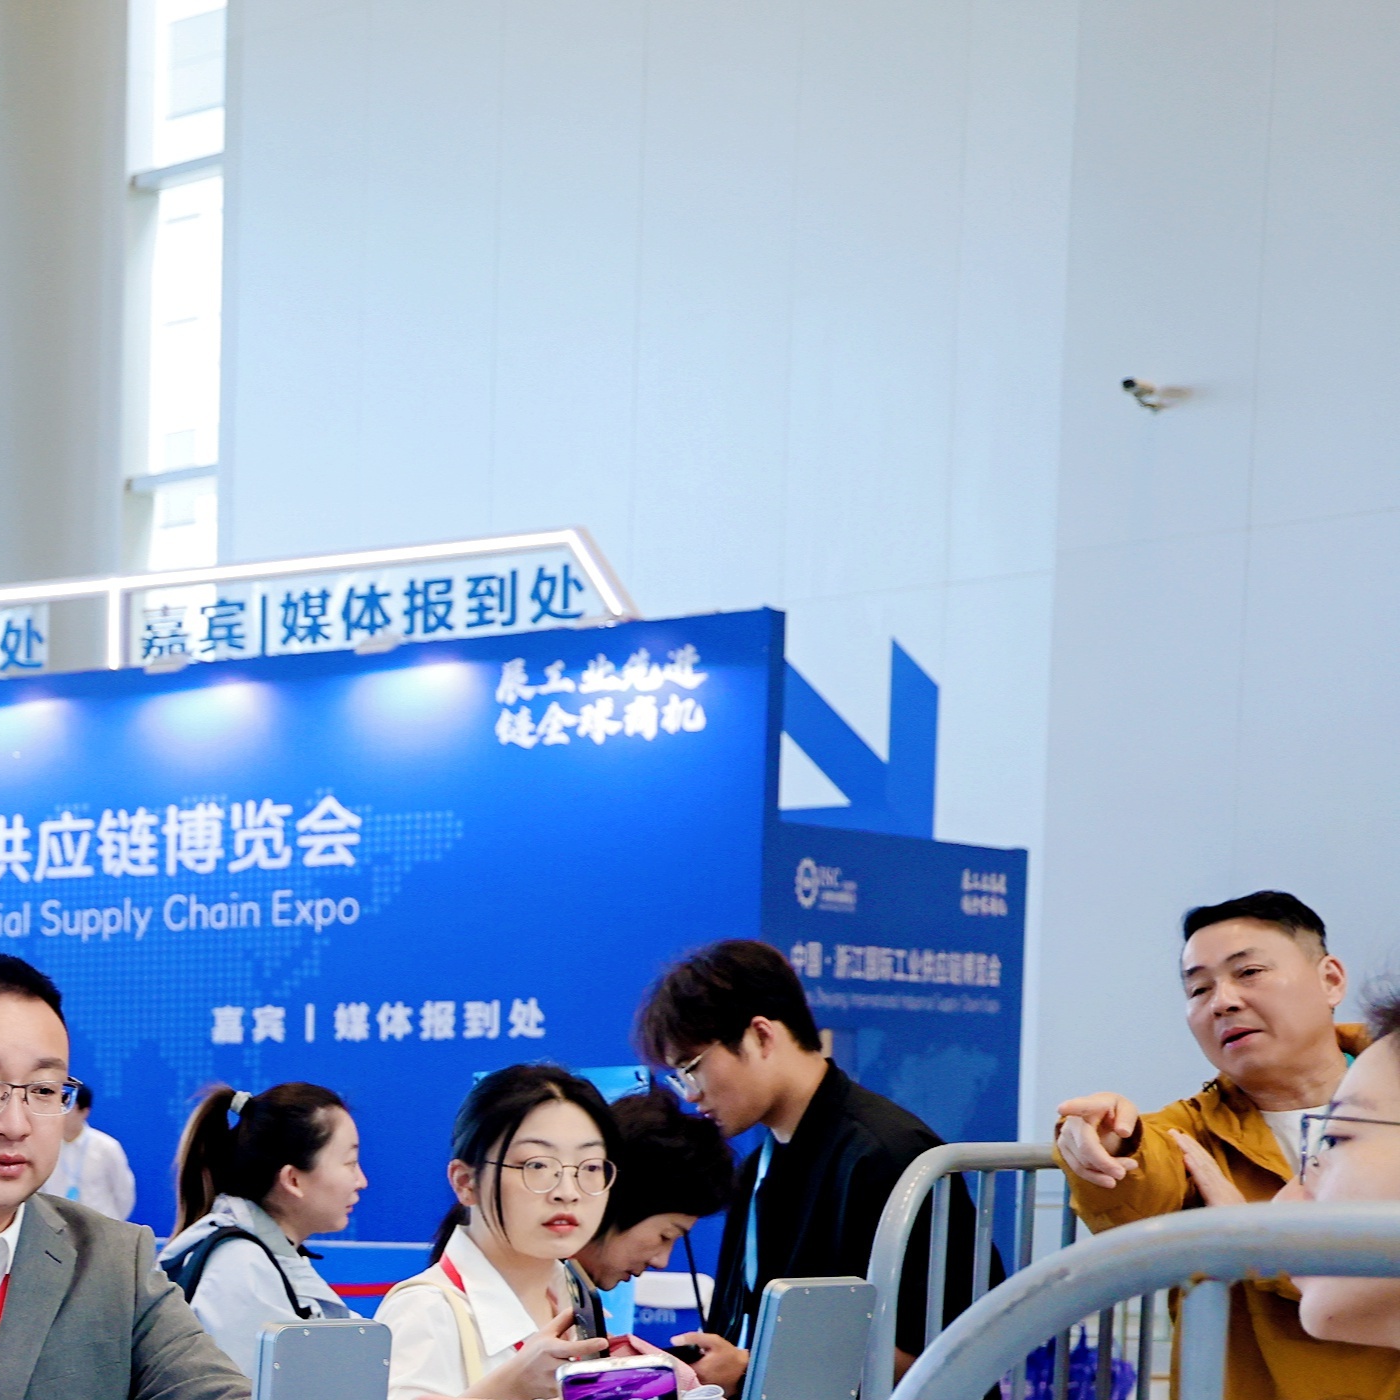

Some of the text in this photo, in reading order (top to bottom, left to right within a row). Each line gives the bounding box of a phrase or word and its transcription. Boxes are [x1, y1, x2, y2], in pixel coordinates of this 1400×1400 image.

[40, 896, 153, 943] Supply
[163, 890, 261, 933] Chain
[271, 888, 360, 933] Expo
